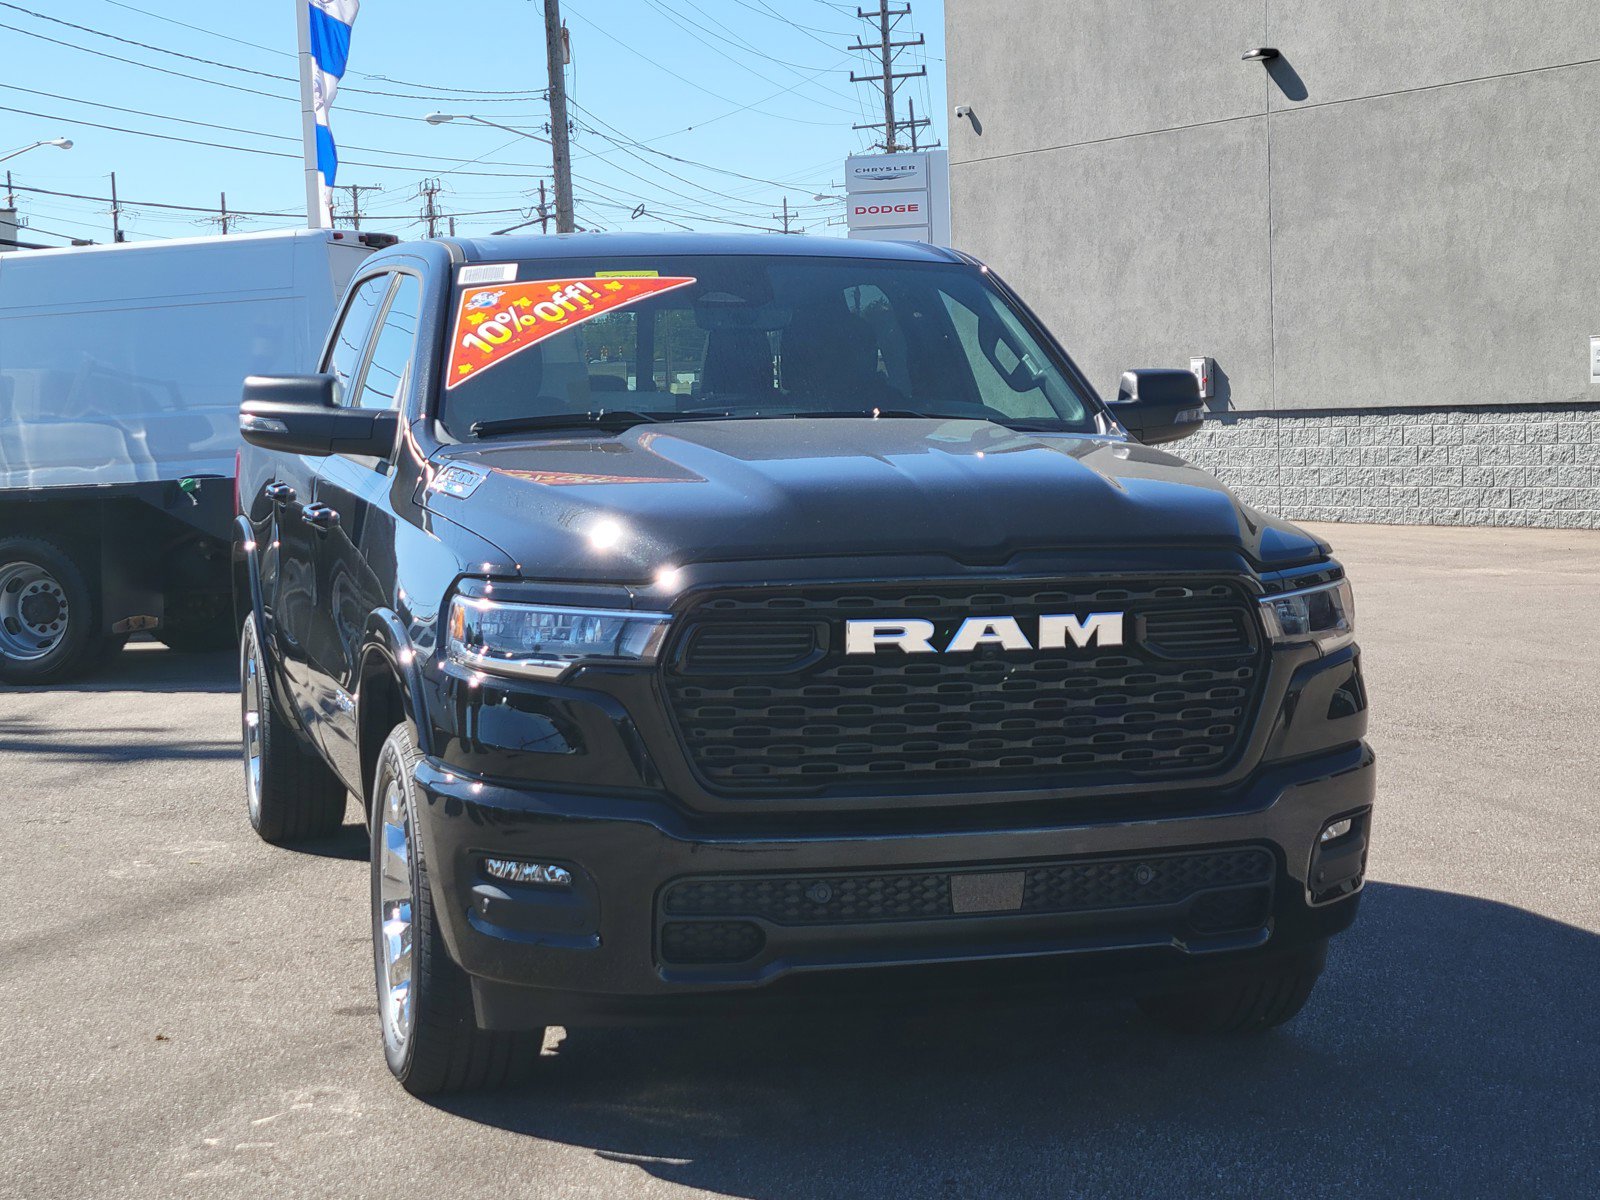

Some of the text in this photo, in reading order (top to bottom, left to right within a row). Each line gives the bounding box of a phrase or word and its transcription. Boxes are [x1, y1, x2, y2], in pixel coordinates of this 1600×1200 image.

[855, 165, 915, 173] CHRYSLER
[855, 204, 918, 214] DODGE
[462, 305, 537, 354] 10%
[533, 281, 602, 322] Off!
[845, 612, 1125, 655] RAM
